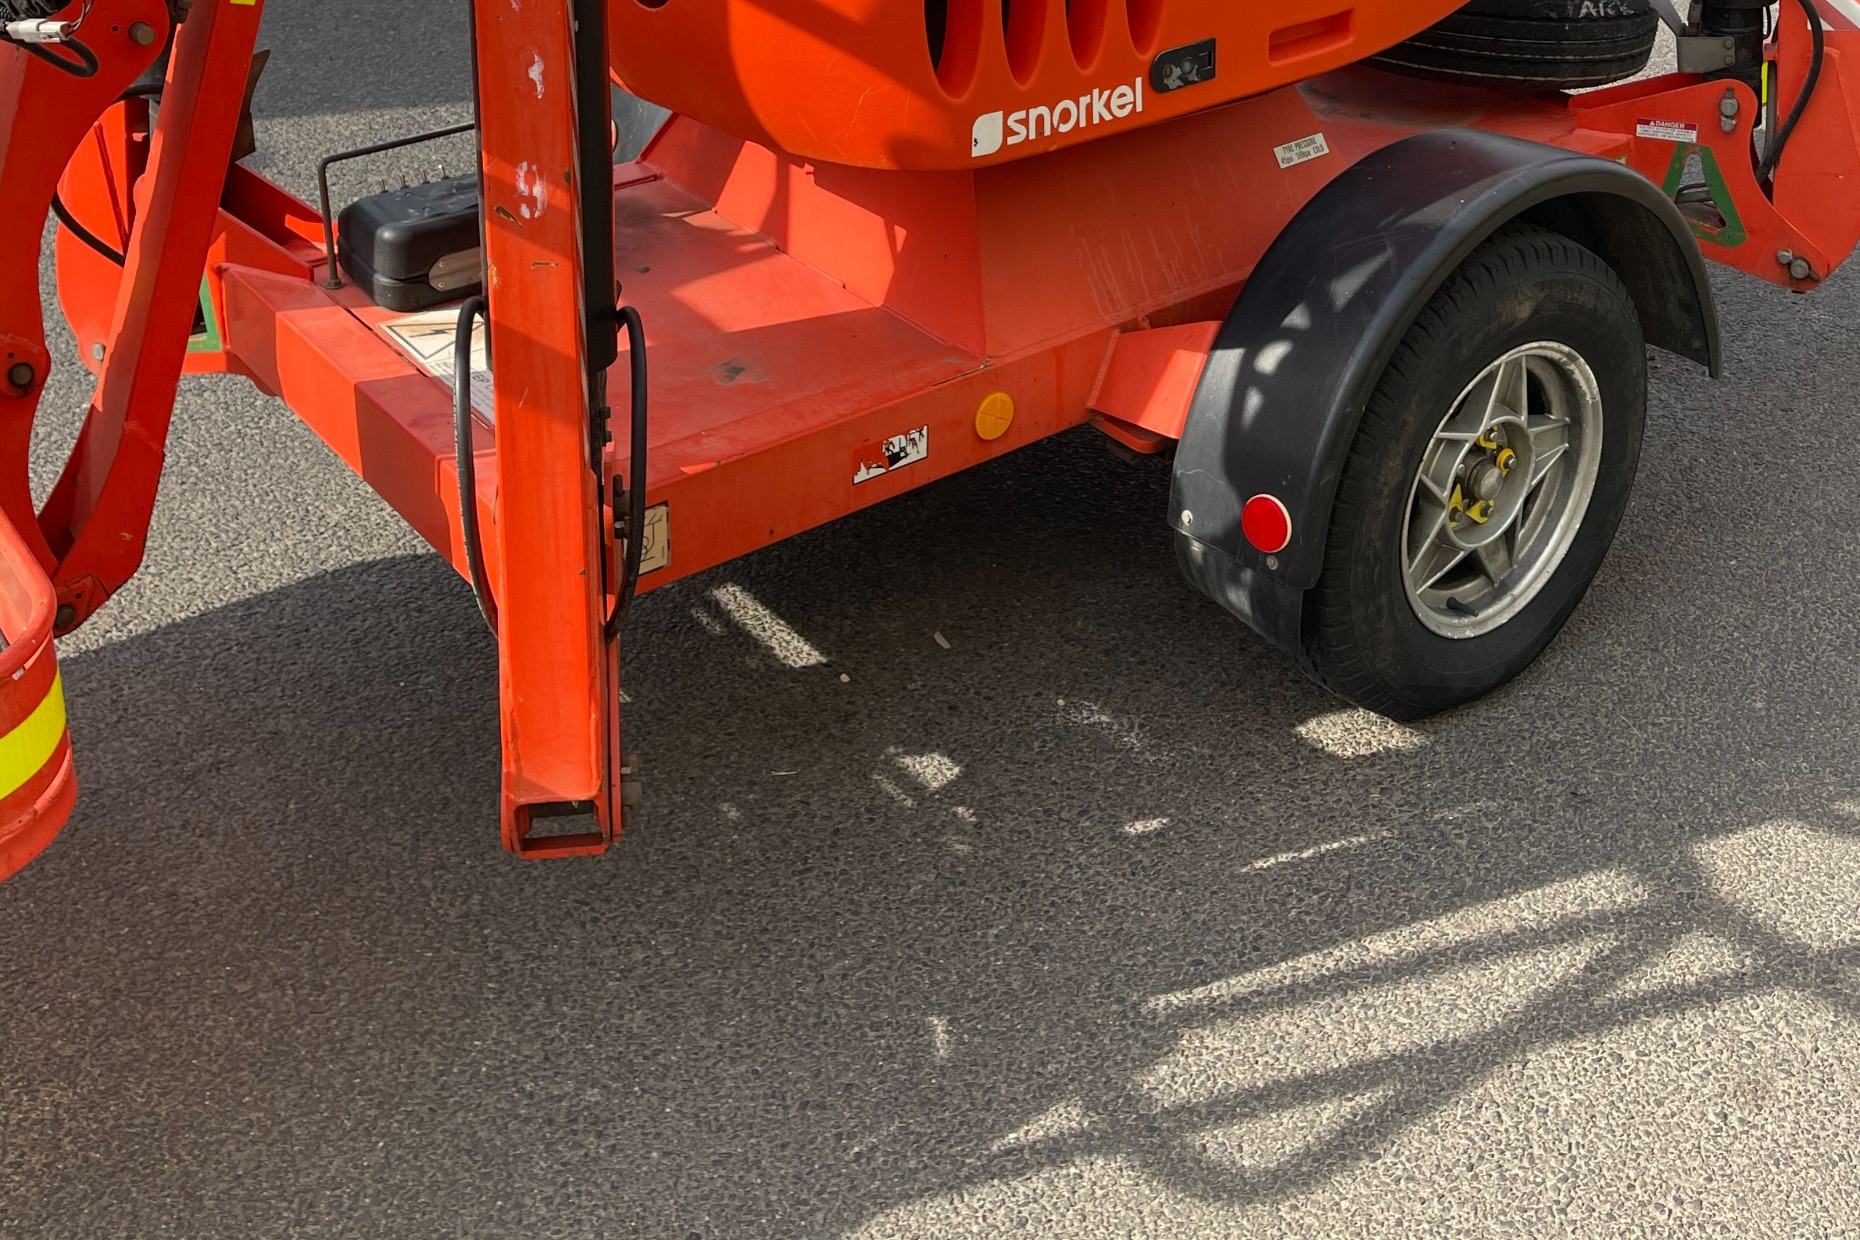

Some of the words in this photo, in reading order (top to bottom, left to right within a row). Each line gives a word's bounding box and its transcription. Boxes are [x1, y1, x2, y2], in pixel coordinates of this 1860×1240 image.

[1006, 76, 1143, 146] snorkel
[1655, 120, 1685, 130] DANGER
[1294, 137, 1317, 151] PRESSURE
